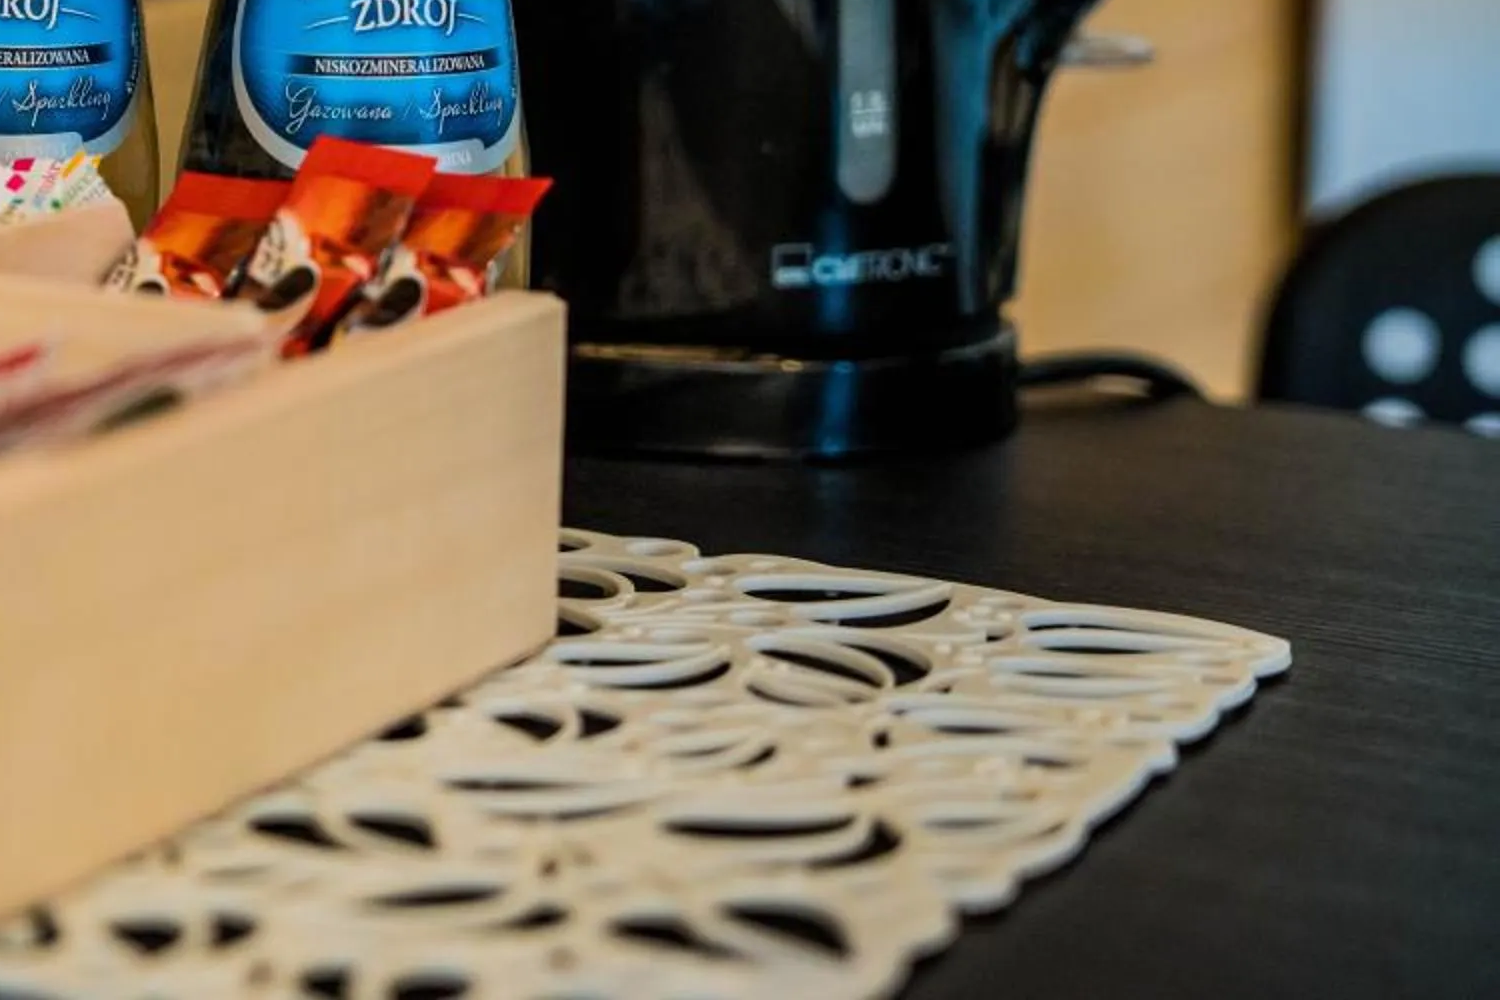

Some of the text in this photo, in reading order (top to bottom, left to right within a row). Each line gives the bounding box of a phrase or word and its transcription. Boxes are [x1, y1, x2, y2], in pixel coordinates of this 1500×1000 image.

[315, 53, 485, 75] NISKOZMINERALIZOWANA
[13, 74, 112, 127] Sparkling
[285, 77, 393, 134] Gazowana
